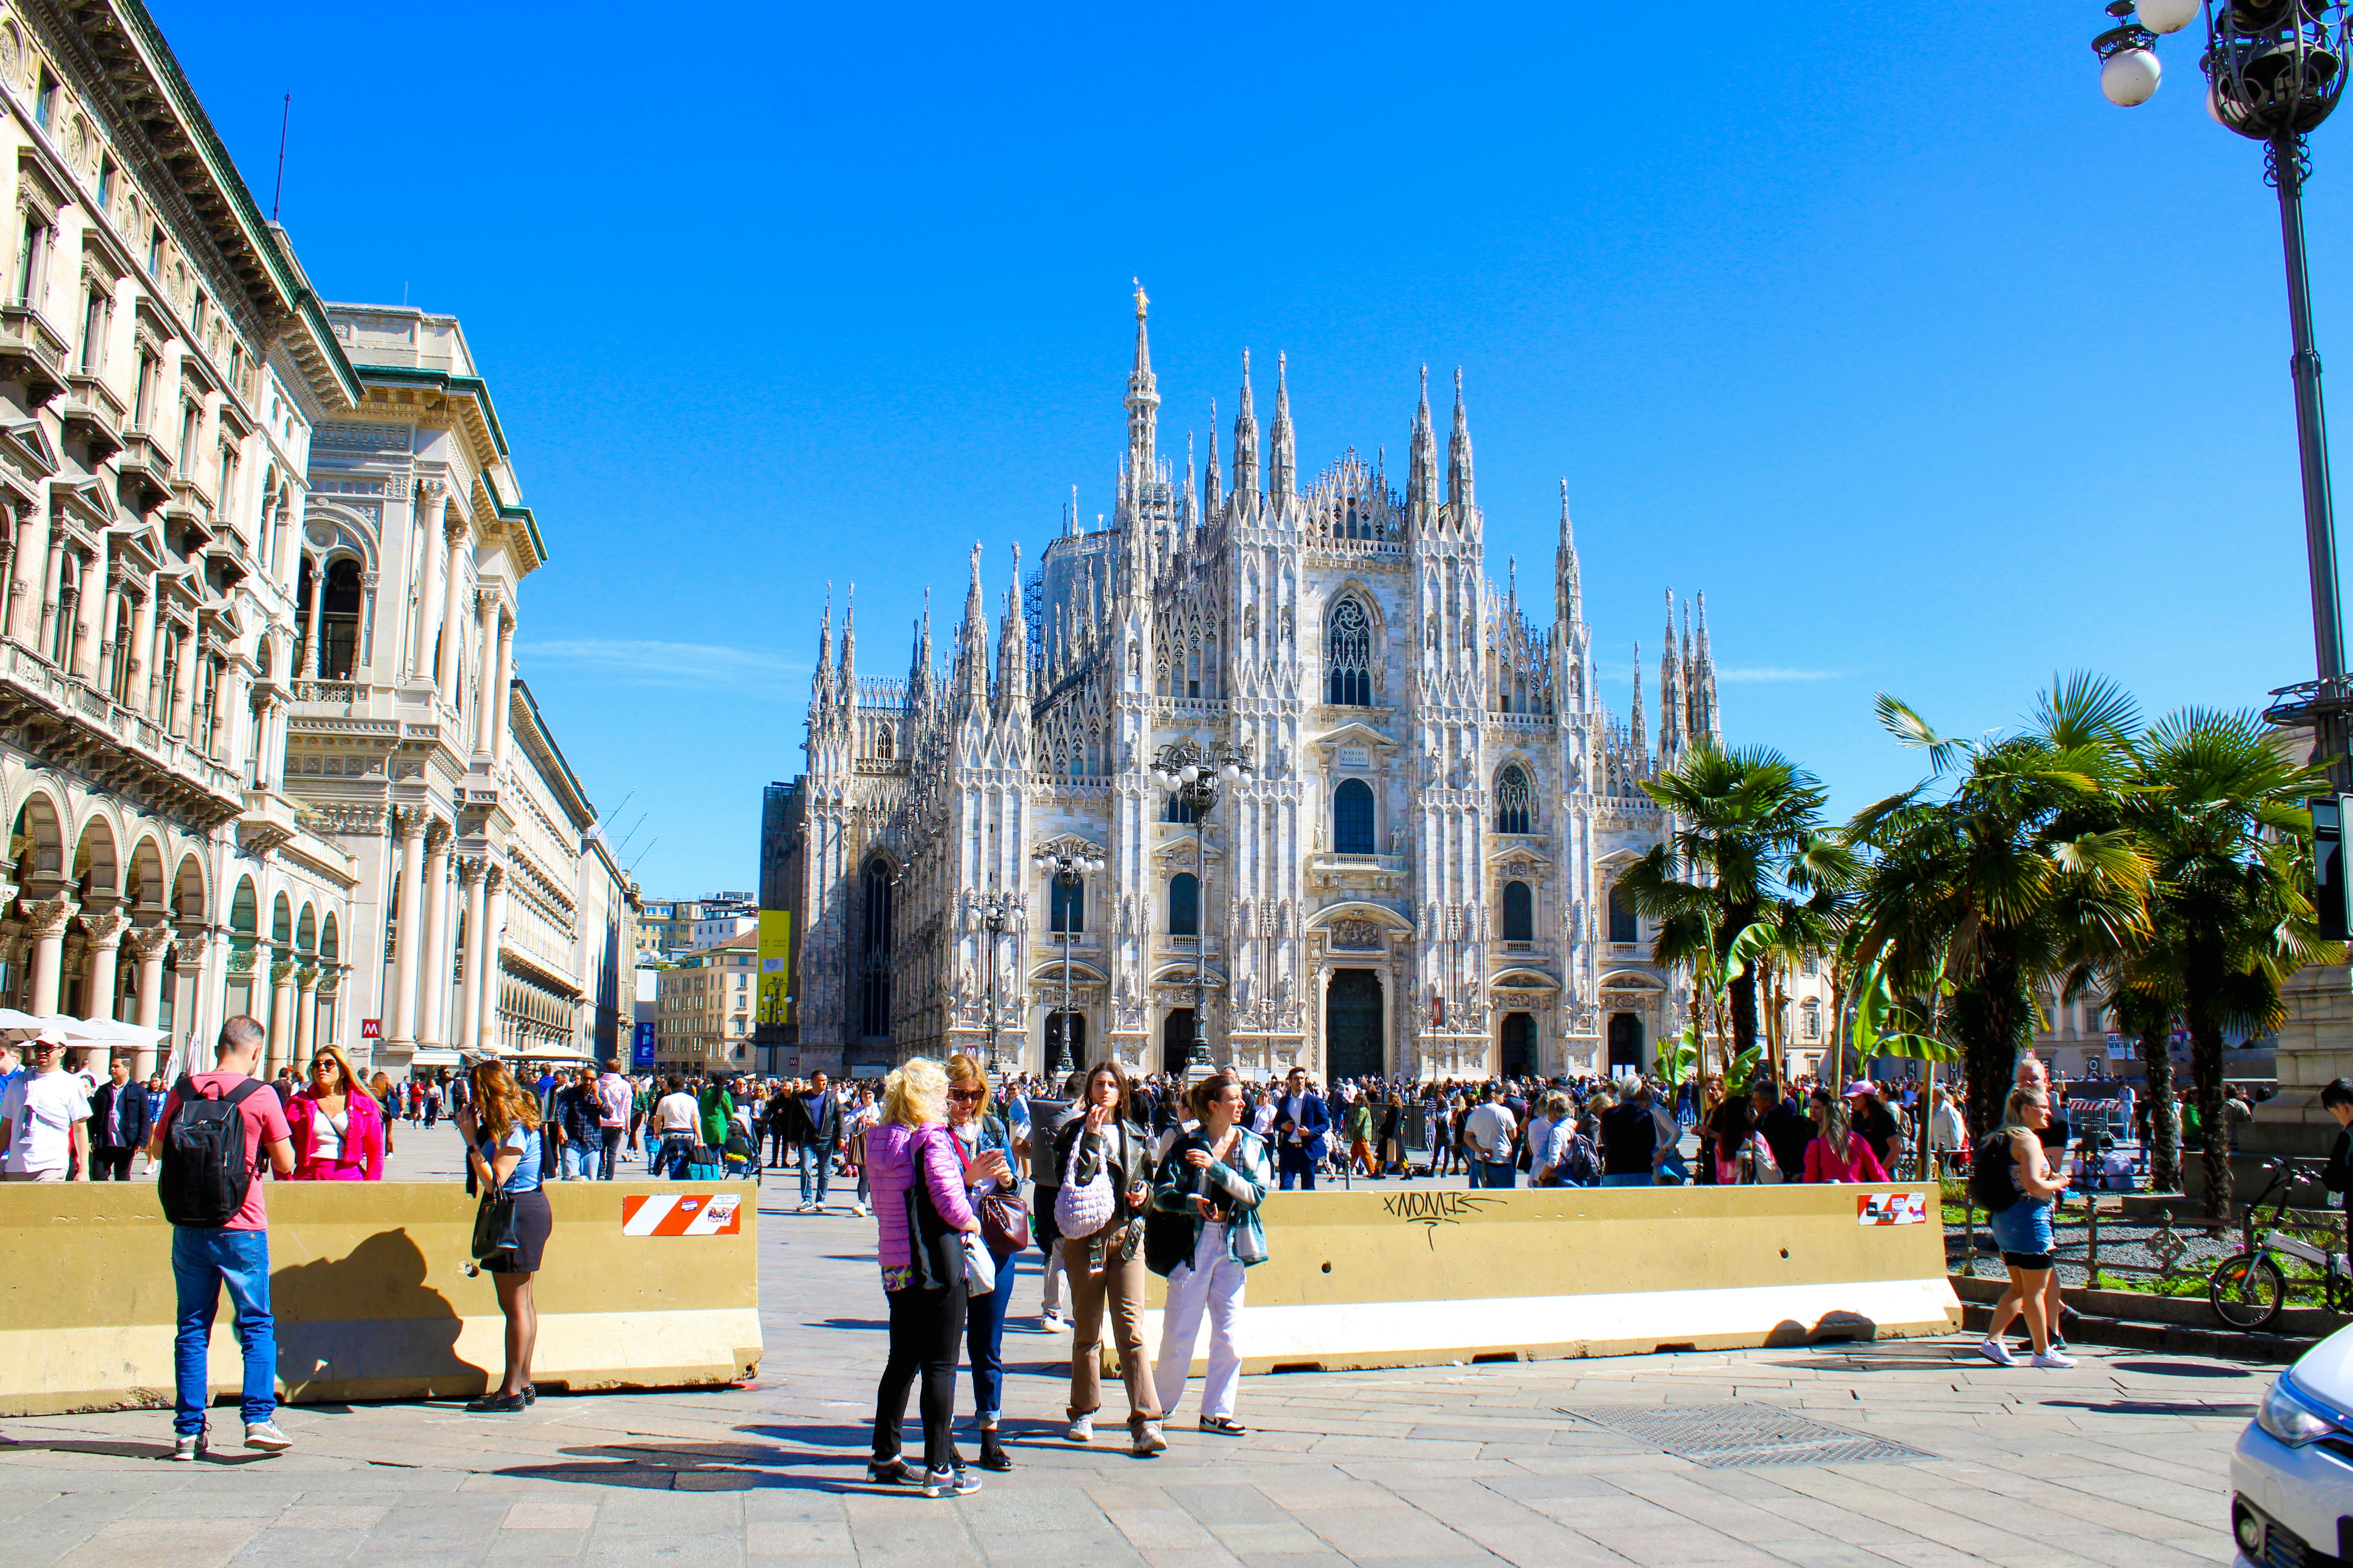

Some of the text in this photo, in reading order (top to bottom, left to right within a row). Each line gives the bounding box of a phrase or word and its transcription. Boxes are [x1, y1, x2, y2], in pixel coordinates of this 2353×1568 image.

[1433, 1004, 1440, 1019] M
[363, 1023, 379, 1034] M
[966, 1047, 977, 1055] M
